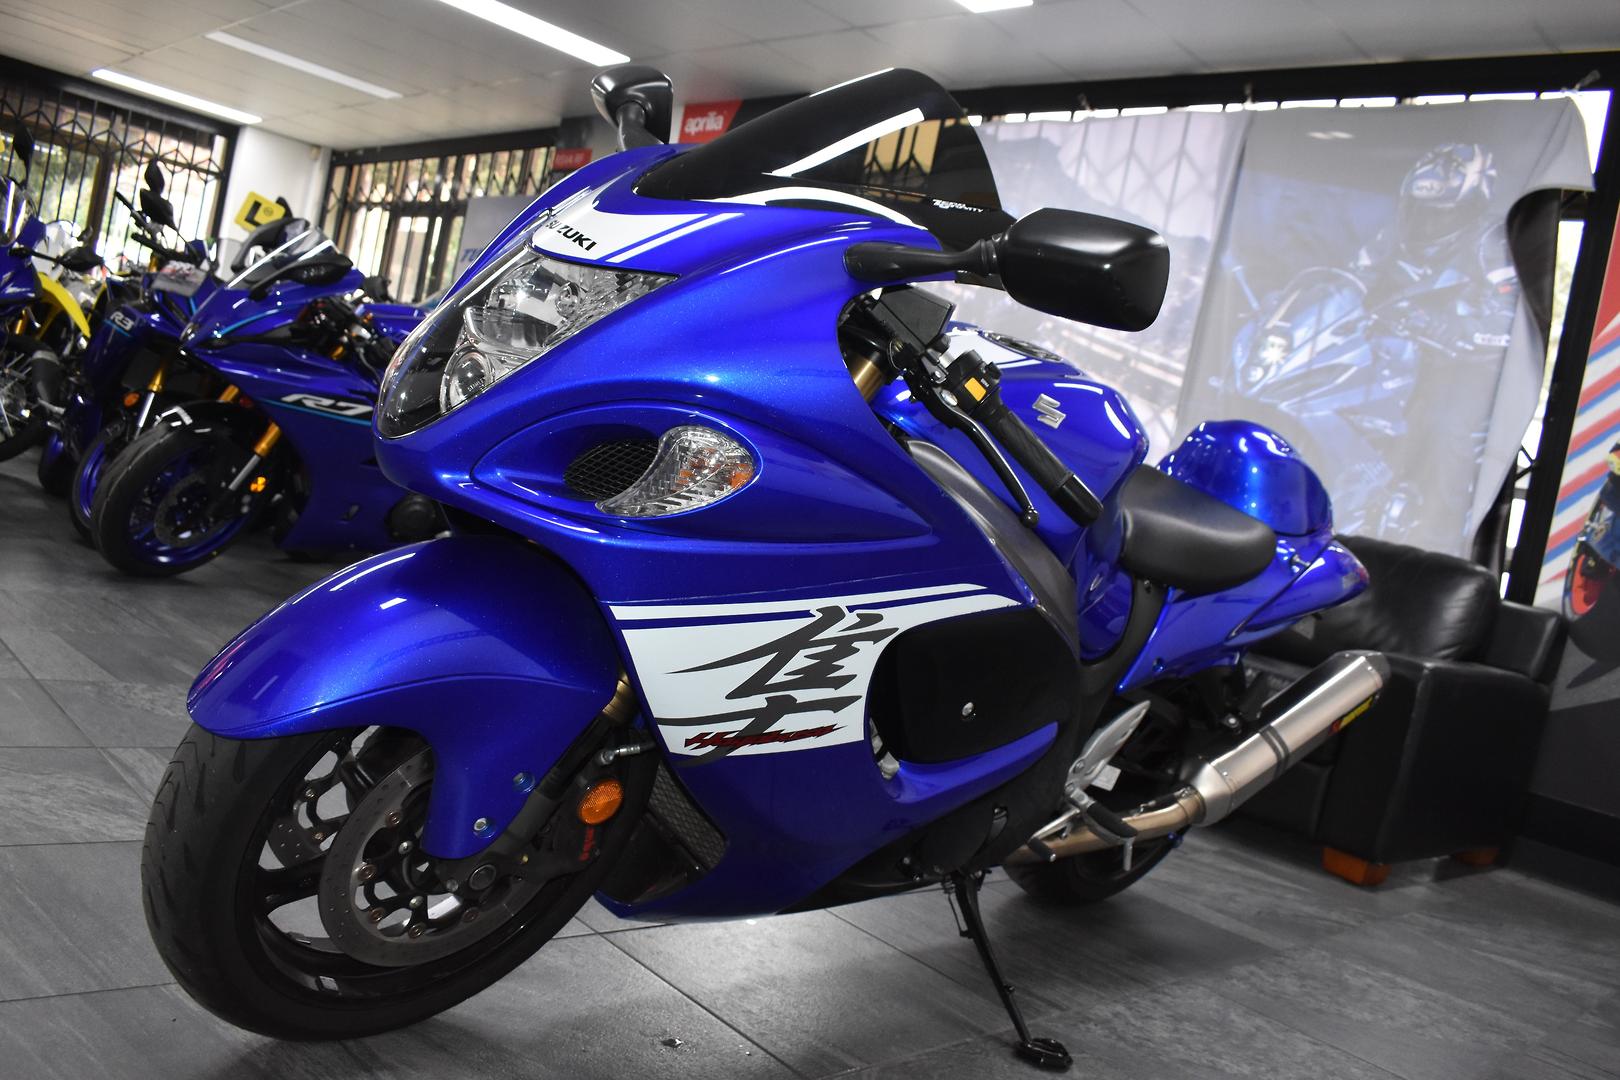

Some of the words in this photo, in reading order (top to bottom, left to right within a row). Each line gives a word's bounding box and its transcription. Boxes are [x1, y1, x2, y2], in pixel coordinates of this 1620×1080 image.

[684, 111, 725, 136] aprilia
[545, 220, 597, 251] SUZUKI
[281, 393, 374, 416] R7
